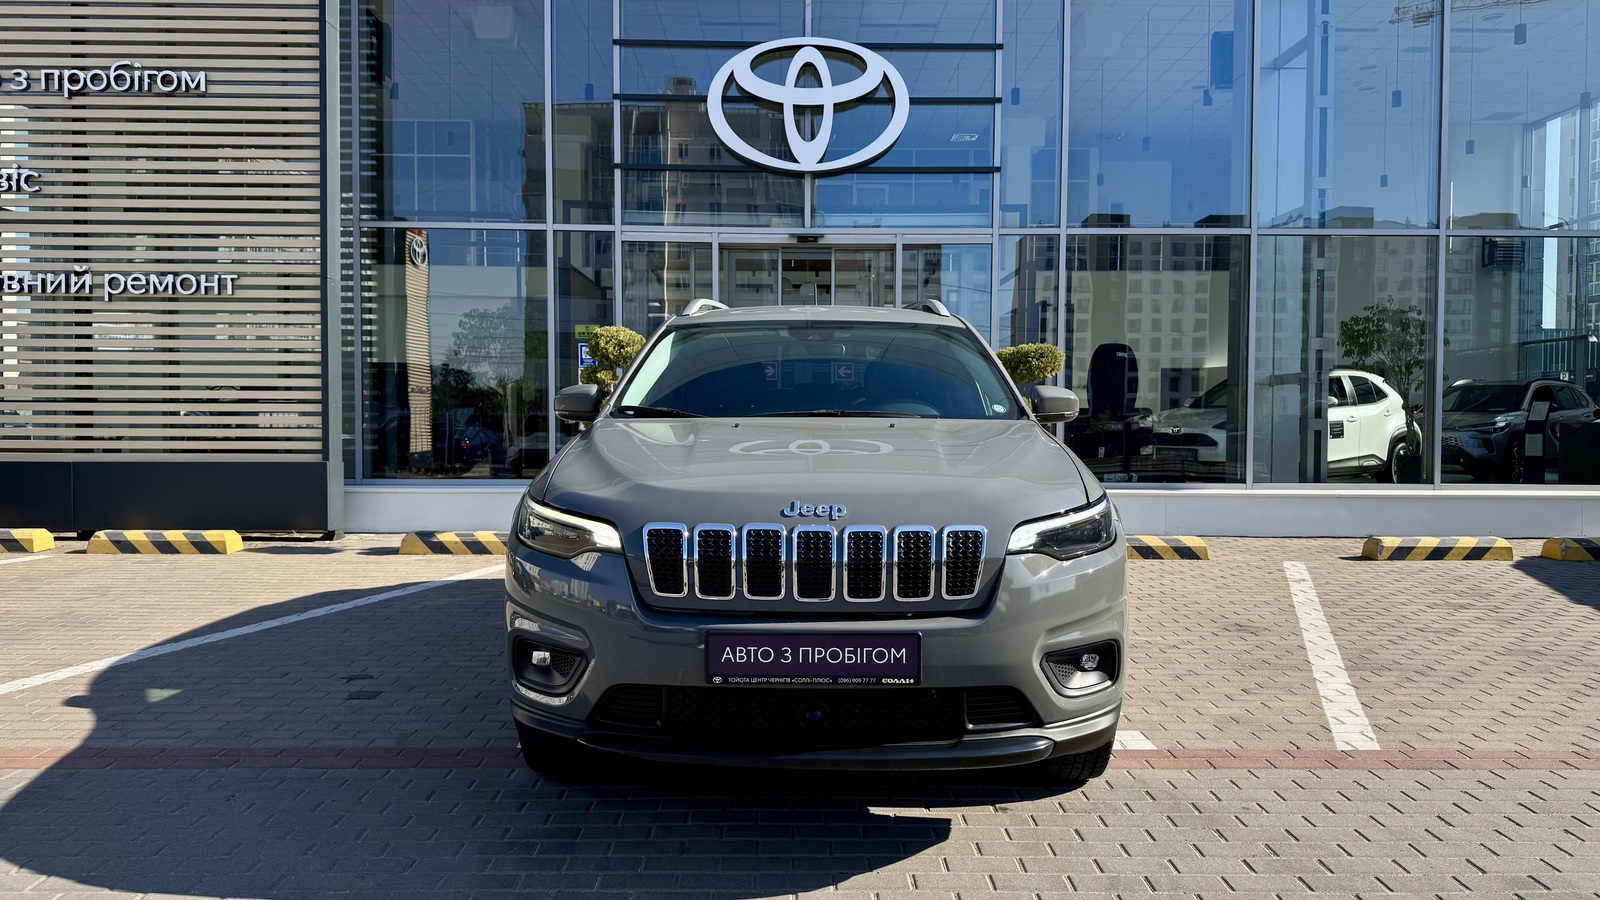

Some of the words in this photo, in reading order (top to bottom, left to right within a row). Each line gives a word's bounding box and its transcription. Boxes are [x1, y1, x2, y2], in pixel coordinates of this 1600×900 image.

[10, 68, 28, 90] з
[40, 60, 207, 99] пробігом
[3, 265, 92, 294] вний
[104, 272, 239, 301] ремонт
[783, 500, 847, 520] Jeep
[721, 647, 775, 663] АВТО
[799, 647, 906, 664] ПРОБІГОМ
